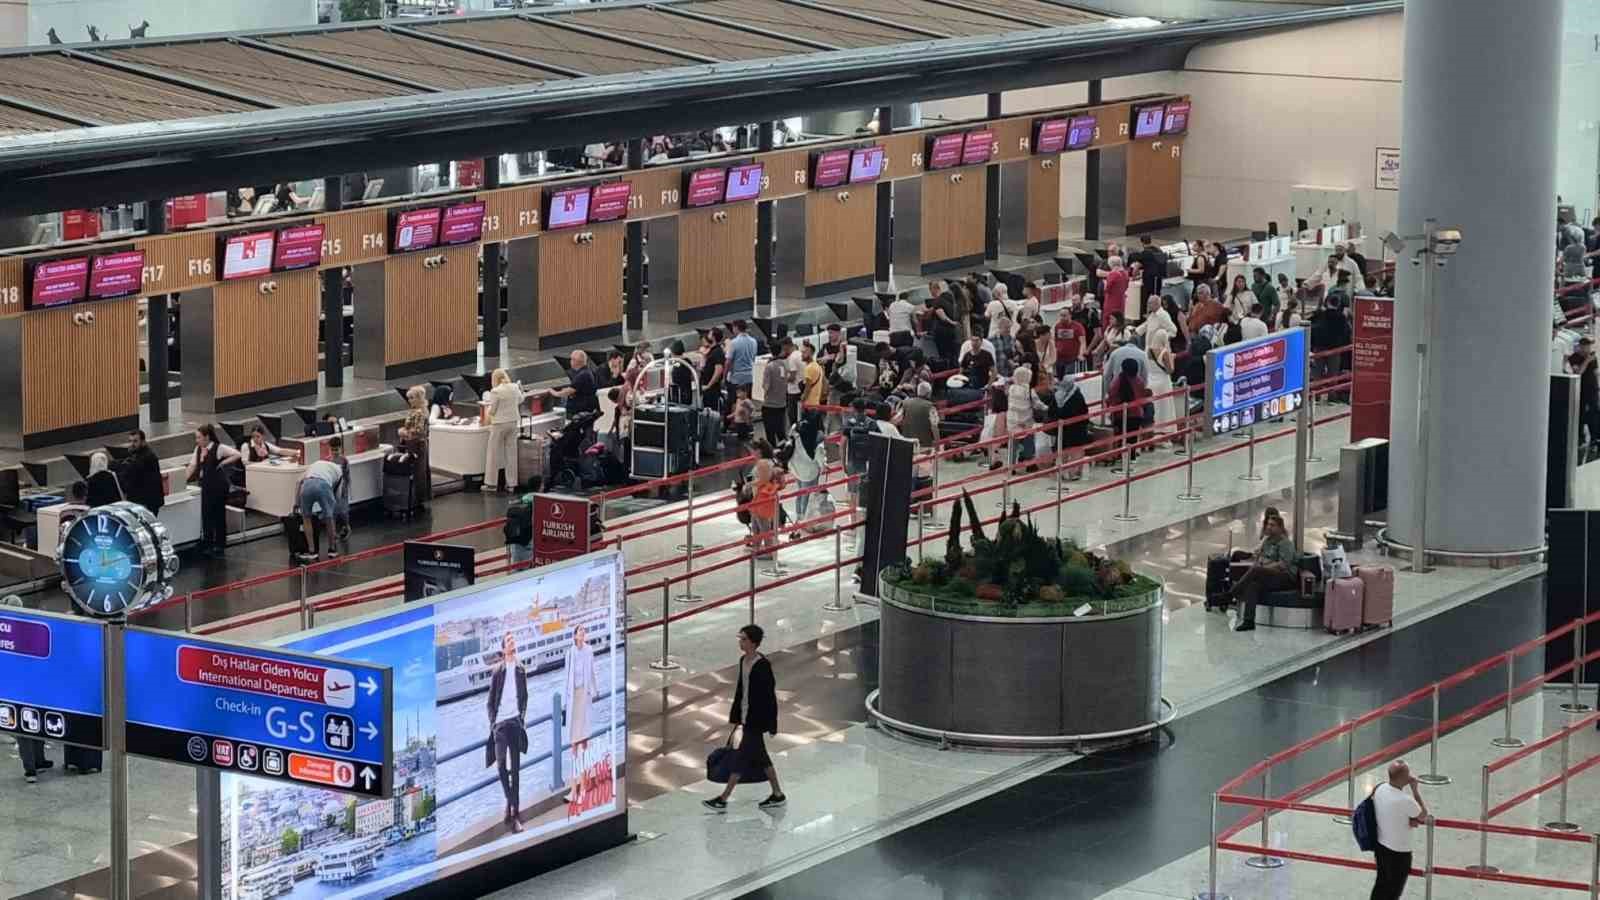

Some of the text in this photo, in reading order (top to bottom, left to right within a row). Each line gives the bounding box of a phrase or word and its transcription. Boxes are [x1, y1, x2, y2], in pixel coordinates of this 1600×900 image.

[1019, 137, 1029, 150] F4
[661, 189, 679, 205] F10
[519, 210, 539, 227] F12
[321, 239, 342, 257] F15
[362, 233, 384, 249] F14
[141, 265, 164, 284] F17
[188, 258, 211, 277] F16
[0, 286, 19, 304] 18
[97, 514, 109, 534] 12
[541, 527, 575, 539] AIRLINES
[543, 519, 575, 531] TURKISH
[103, 593, 112, 612] 6
[212, 654, 319, 682] Dış Hatlar Giden Yolcu
[198, 669, 319, 699] International Departures
[215, 697, 315, 743] Check-in G-S
[215, 744, 229, 756] VAT
